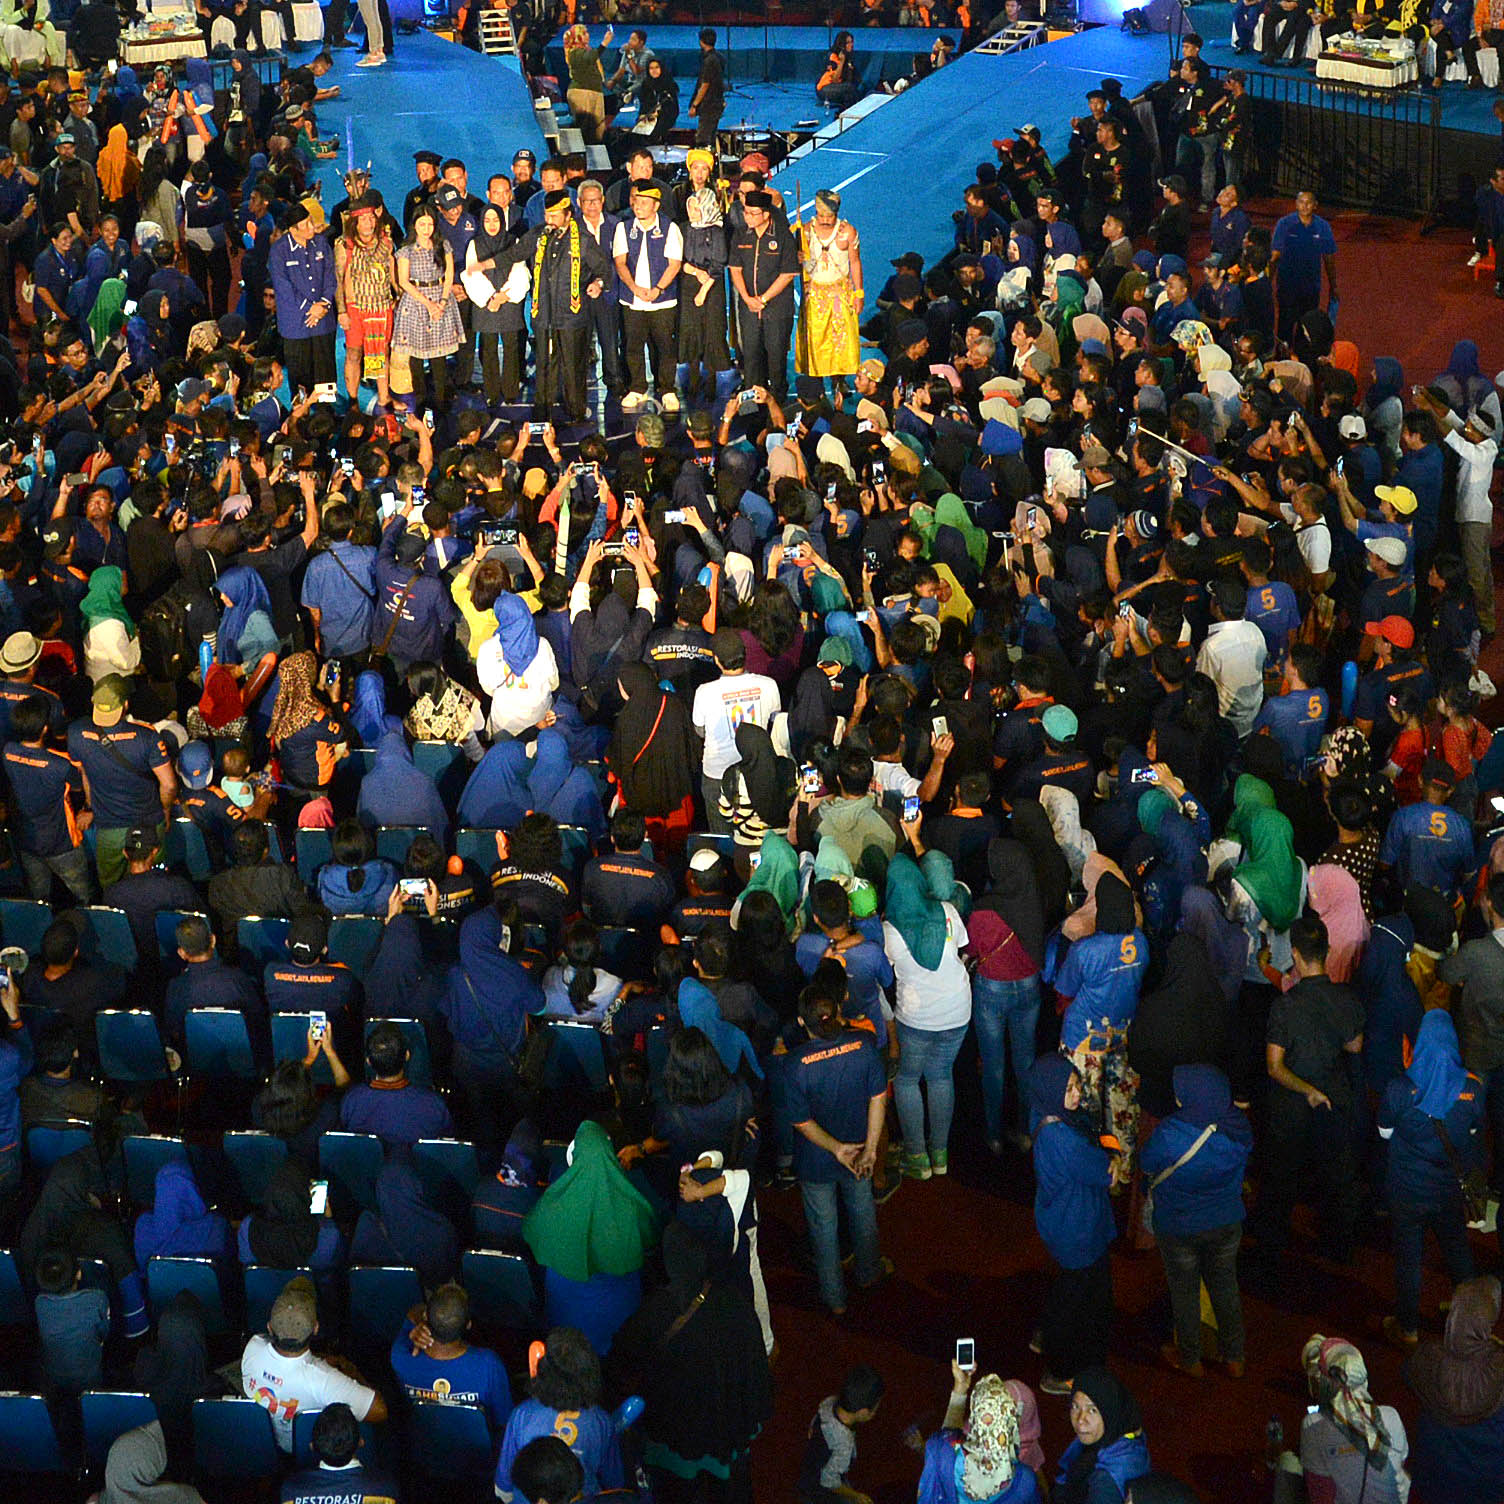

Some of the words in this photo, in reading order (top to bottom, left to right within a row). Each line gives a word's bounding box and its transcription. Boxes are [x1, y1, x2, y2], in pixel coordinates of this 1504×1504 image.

[1261, 588, 1275, 610] 5
[1308, 695, 1322, 719] 5
[1430, 812, 1448, 837] 5
[1120, 935, 1136, 964] 5
